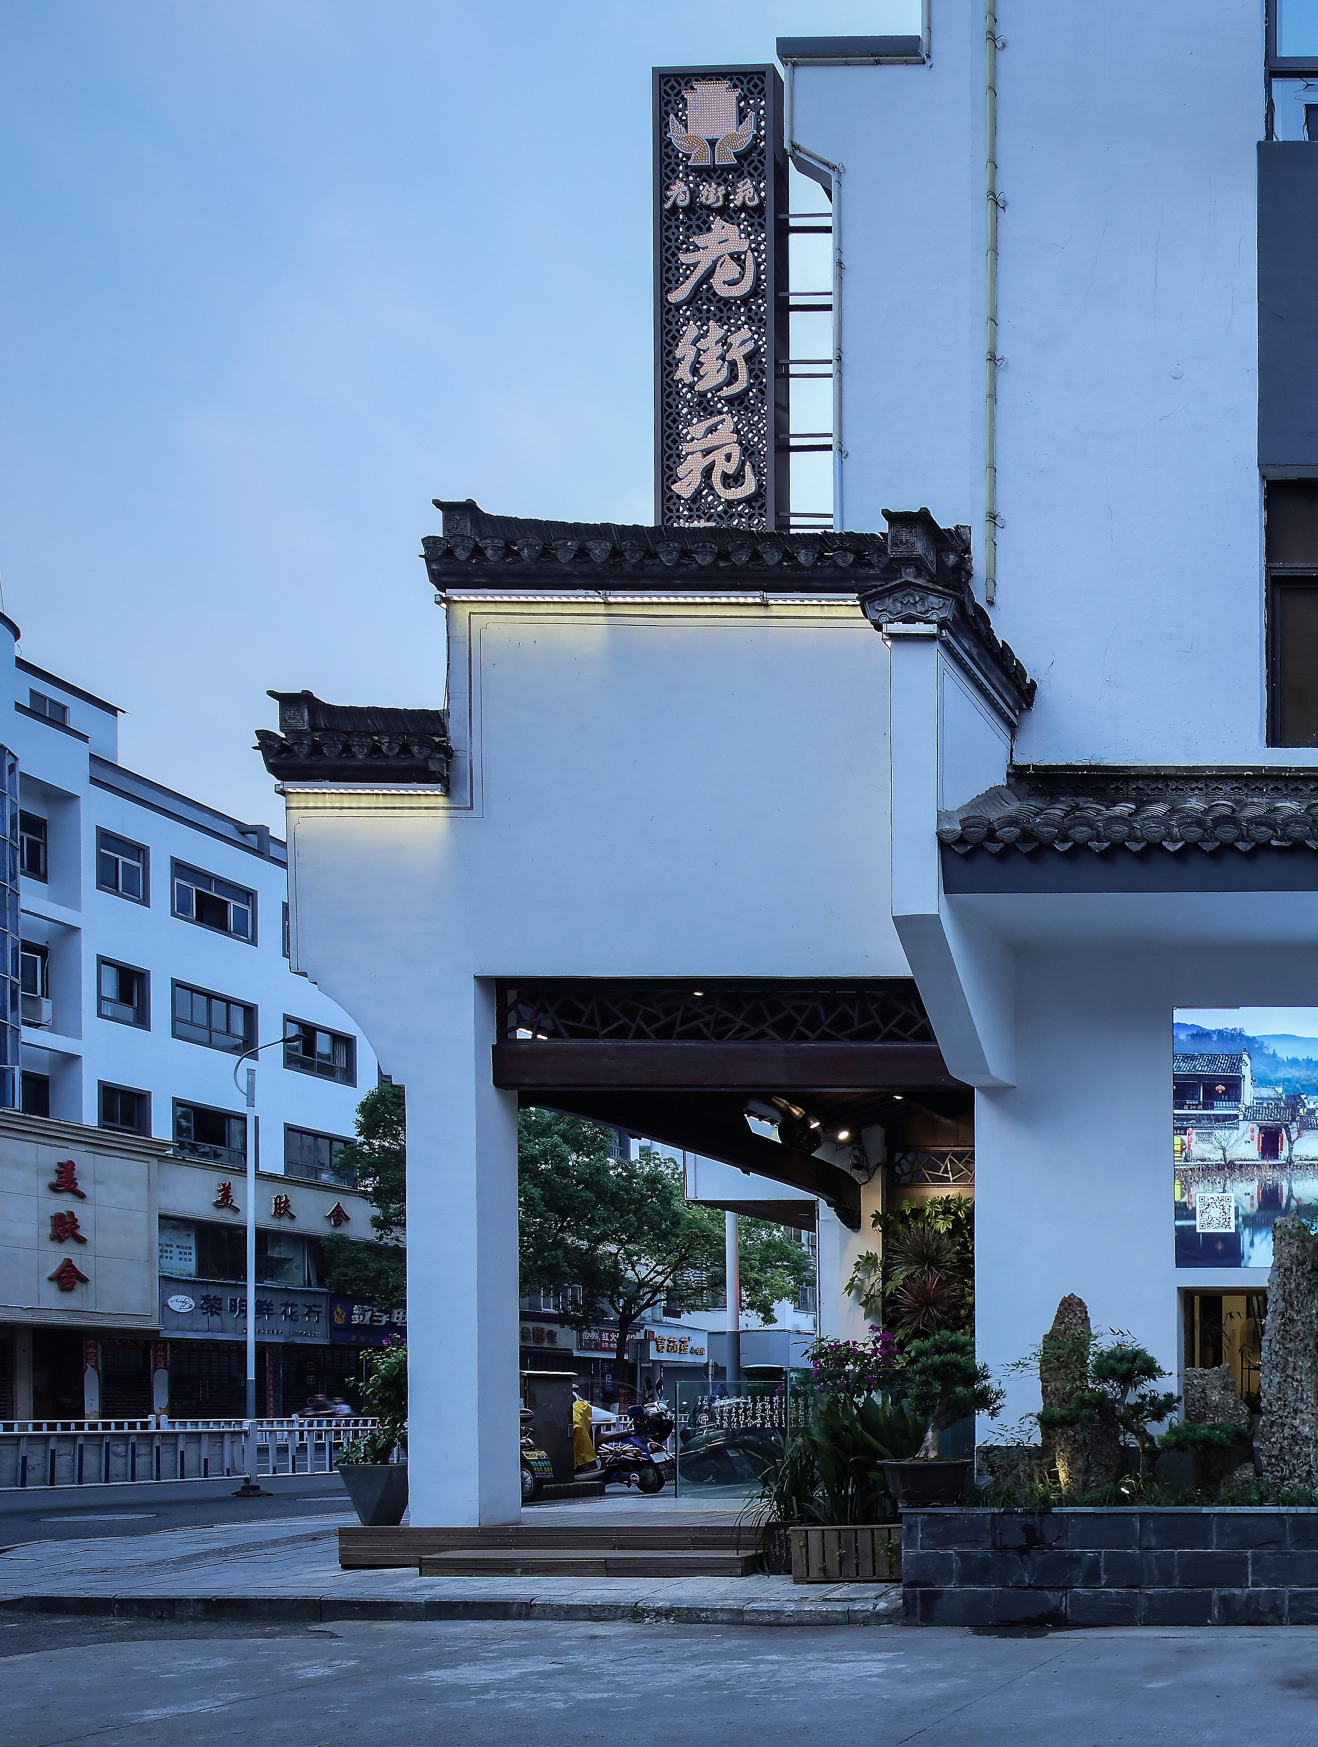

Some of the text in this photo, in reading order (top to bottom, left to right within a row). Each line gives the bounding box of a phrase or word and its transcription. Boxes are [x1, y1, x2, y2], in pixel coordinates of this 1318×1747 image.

[667, 216, 758, 500] 老街苑
[49, 1159, 89, 1292] 美肤舍
[213, 1180, 351, 1227] 美肤舍
[200, 1294, 323, 1323] 黎明鲜花行
